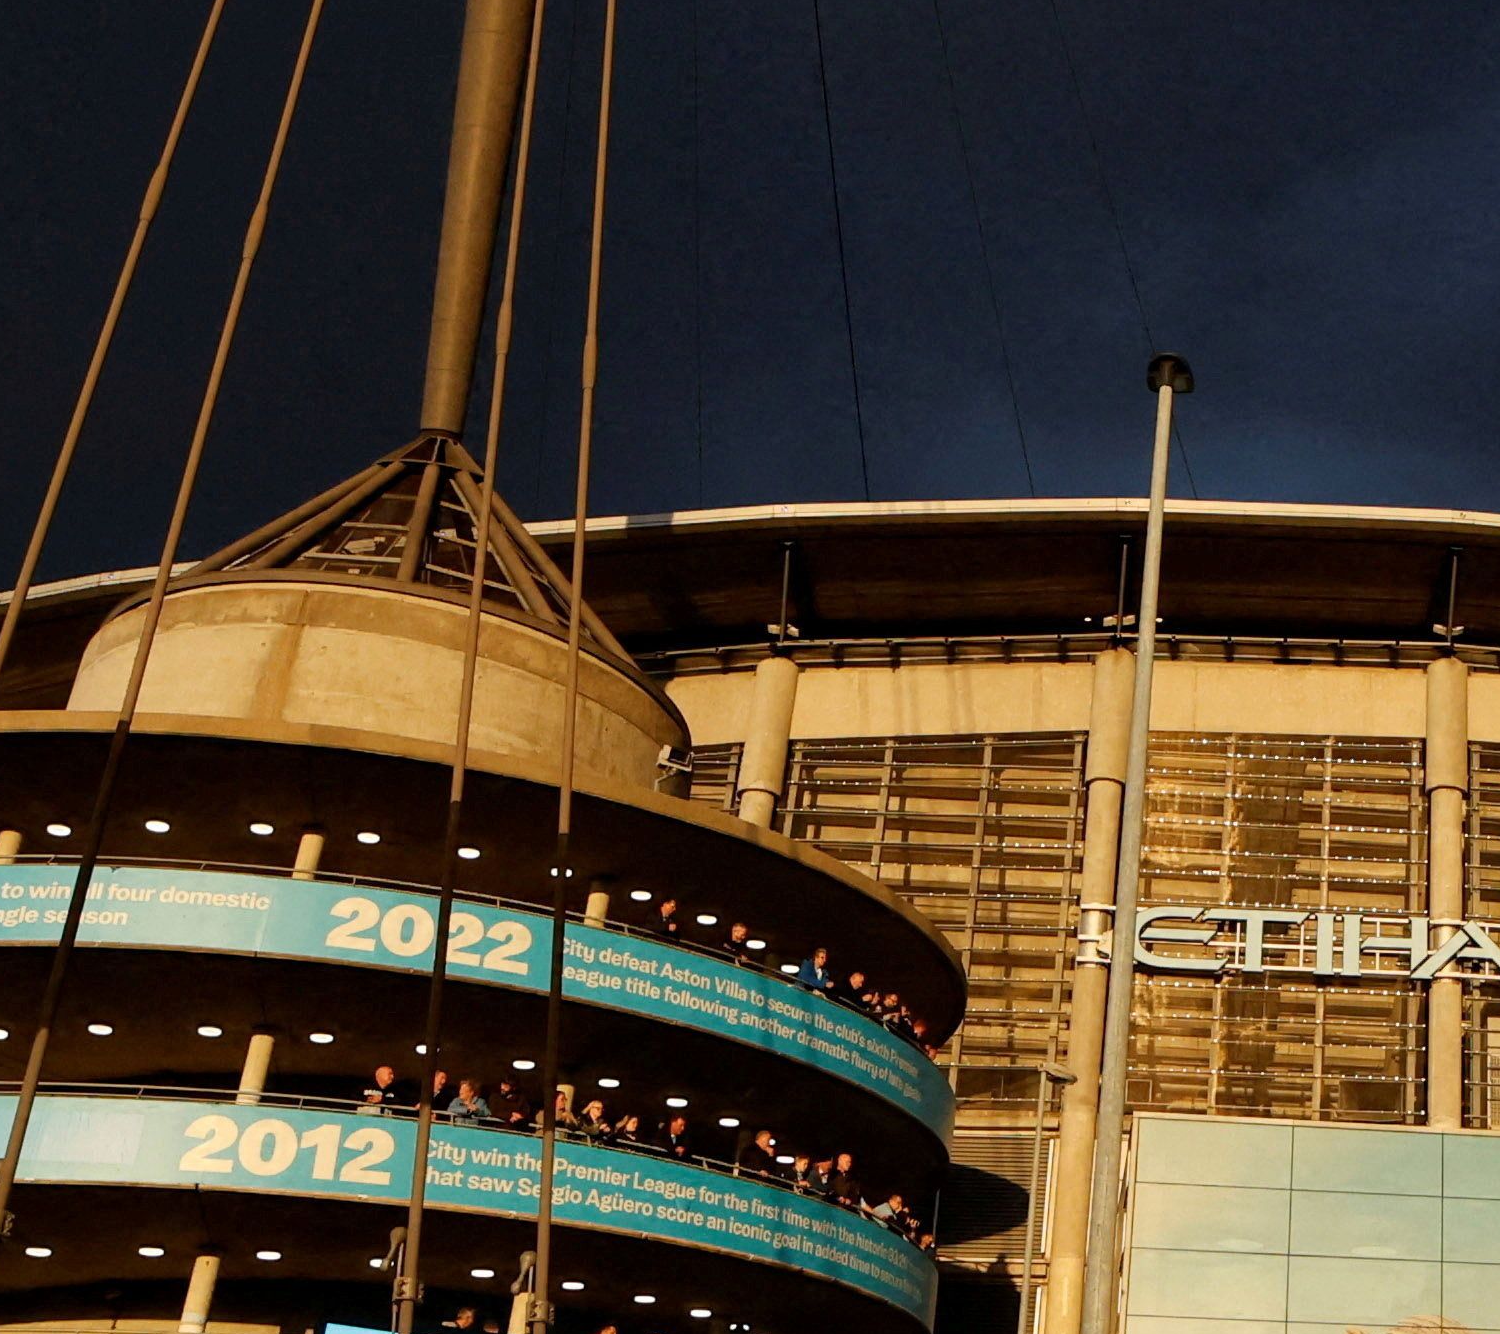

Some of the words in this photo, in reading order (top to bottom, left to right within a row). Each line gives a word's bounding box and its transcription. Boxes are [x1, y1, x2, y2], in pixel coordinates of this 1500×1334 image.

[1, 881, 26, 900] to
[107, 881, 157, 903] four
[160, 884, 272, 911] domestic
[325, 897, 535, 976] 2022
[599, 947, 659, 976] defeat
[660, 961, 712, 991] Aston
[714, 976, 750, 1003] Villa
[750, 988, 766, 1008] to
[625, 977, 661, 1001] title
[663, 986, 740, 1026] following
[179, 1114, 396, 1186] 2012
[466, 1173, 512, 1196] saw
[586, 1188, 644, 1217] Agüero
[646, 1204, 694, 1226] score
[696, 1213, 717, 1232] an
[718, 1218, 772, 1244] iconic
[470, 1148, 510, 1172] win
[553, 1157, 632, 1188] Premier
[633, 1171, 687, 1200] League
[699, 1186, 723, 1209] for
[723, 1193, 749, 1214] the
[751, 1197, 780, 1225] first
